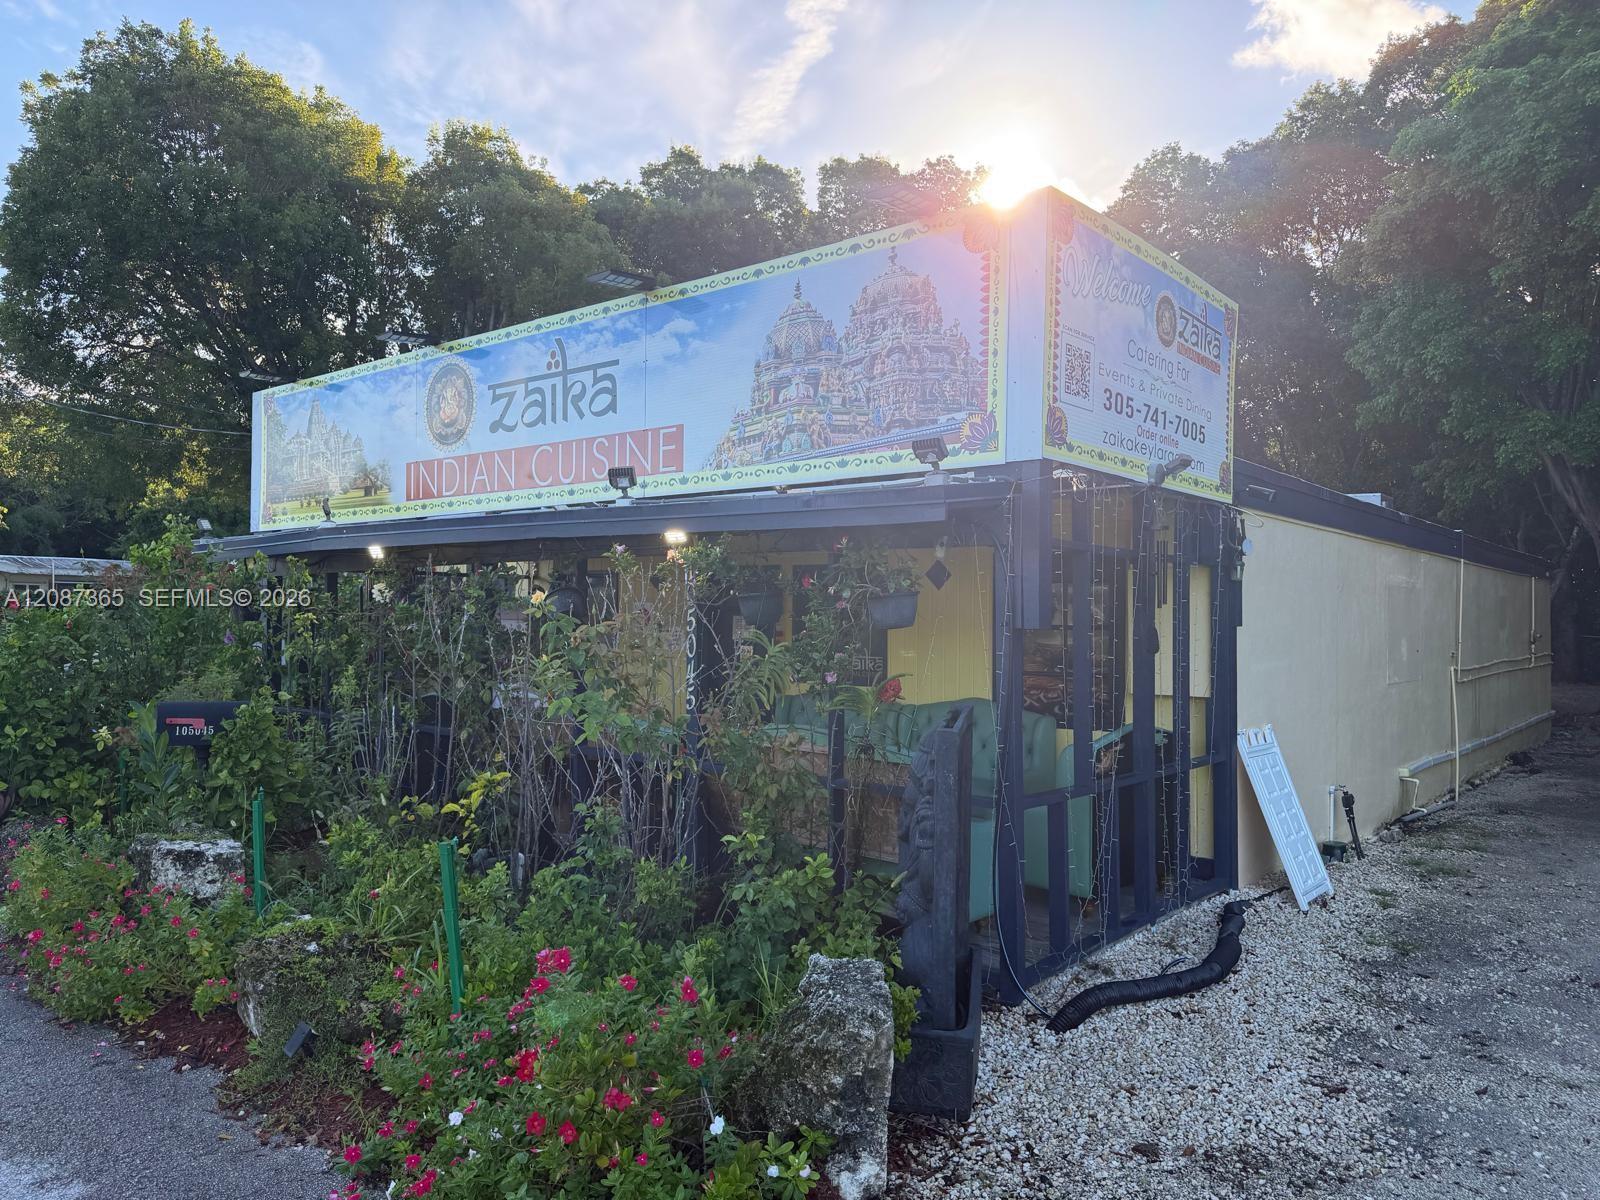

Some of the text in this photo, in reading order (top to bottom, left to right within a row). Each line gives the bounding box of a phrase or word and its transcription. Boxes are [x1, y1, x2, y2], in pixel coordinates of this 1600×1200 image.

[1063, 246, 1152, 306] Welcome
[1128, 339, 1174, 379] Catering
[1176, 361, 1190, 383] For
[1098, 362, 1212, 422] Events & Private Dining
[1103, 388, 1206, 444] 305-741-7005
[410, 427, 677, 499] INDIAN CUISINE
[1102, 431, 1205, 472] zaikakeylargom
[1136, 425, 1179, 449] Order online
